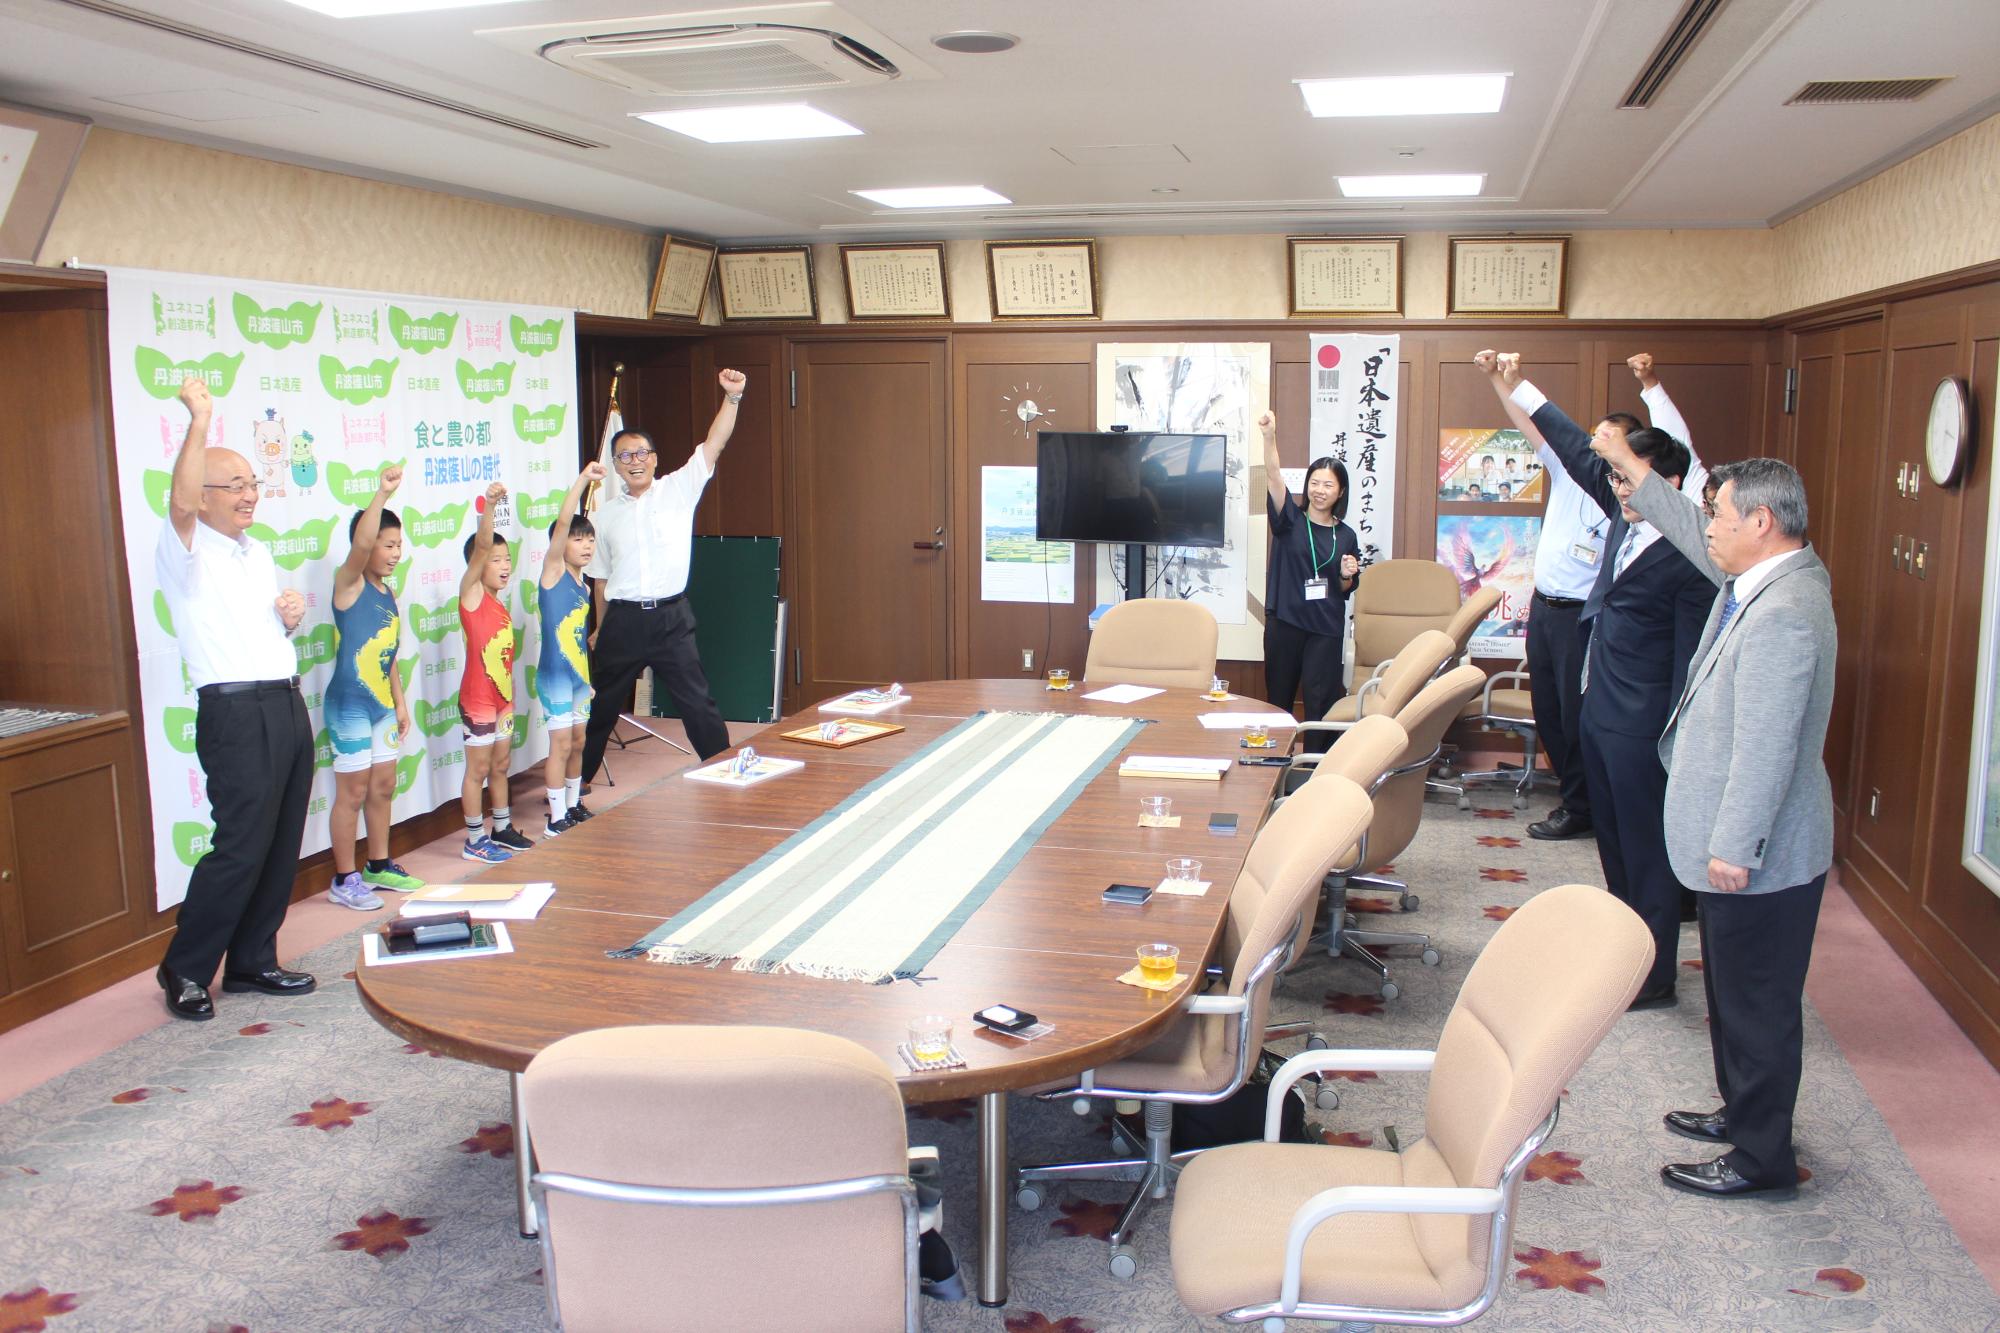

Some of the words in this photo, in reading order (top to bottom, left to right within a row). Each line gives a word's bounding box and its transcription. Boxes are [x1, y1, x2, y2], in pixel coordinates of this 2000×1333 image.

[166, 301, 204, 315] ユネスコ
[166, 318, 205, 332] 創造都市
[247, 315, 304, 336] 丹波篠山市
[342, 313, 371, 324] ユネスコ
[402, 324, 446, 342] 丹波篠山市
[519, 329, 553, 346] 丹波篠山市
[260, 375, 303, 393] 日本遺産
[335, 372, 384, 390] 丹波篠山市
[407, 376, 441, 392] 日本遺産
[466, 377, 505, 393] 丹波篠山市
[414, 420, 491, 449] 食と農の都
[523, 418, 556, 434] 丹波篠山市
[343, 478, 381, 497] 丹波篠山
[413, 519, 455, 538] 丹波篠山市
[425, 657, 458, 677] 日本遺産
[425, 704, 460, 728] 丹波篠山
